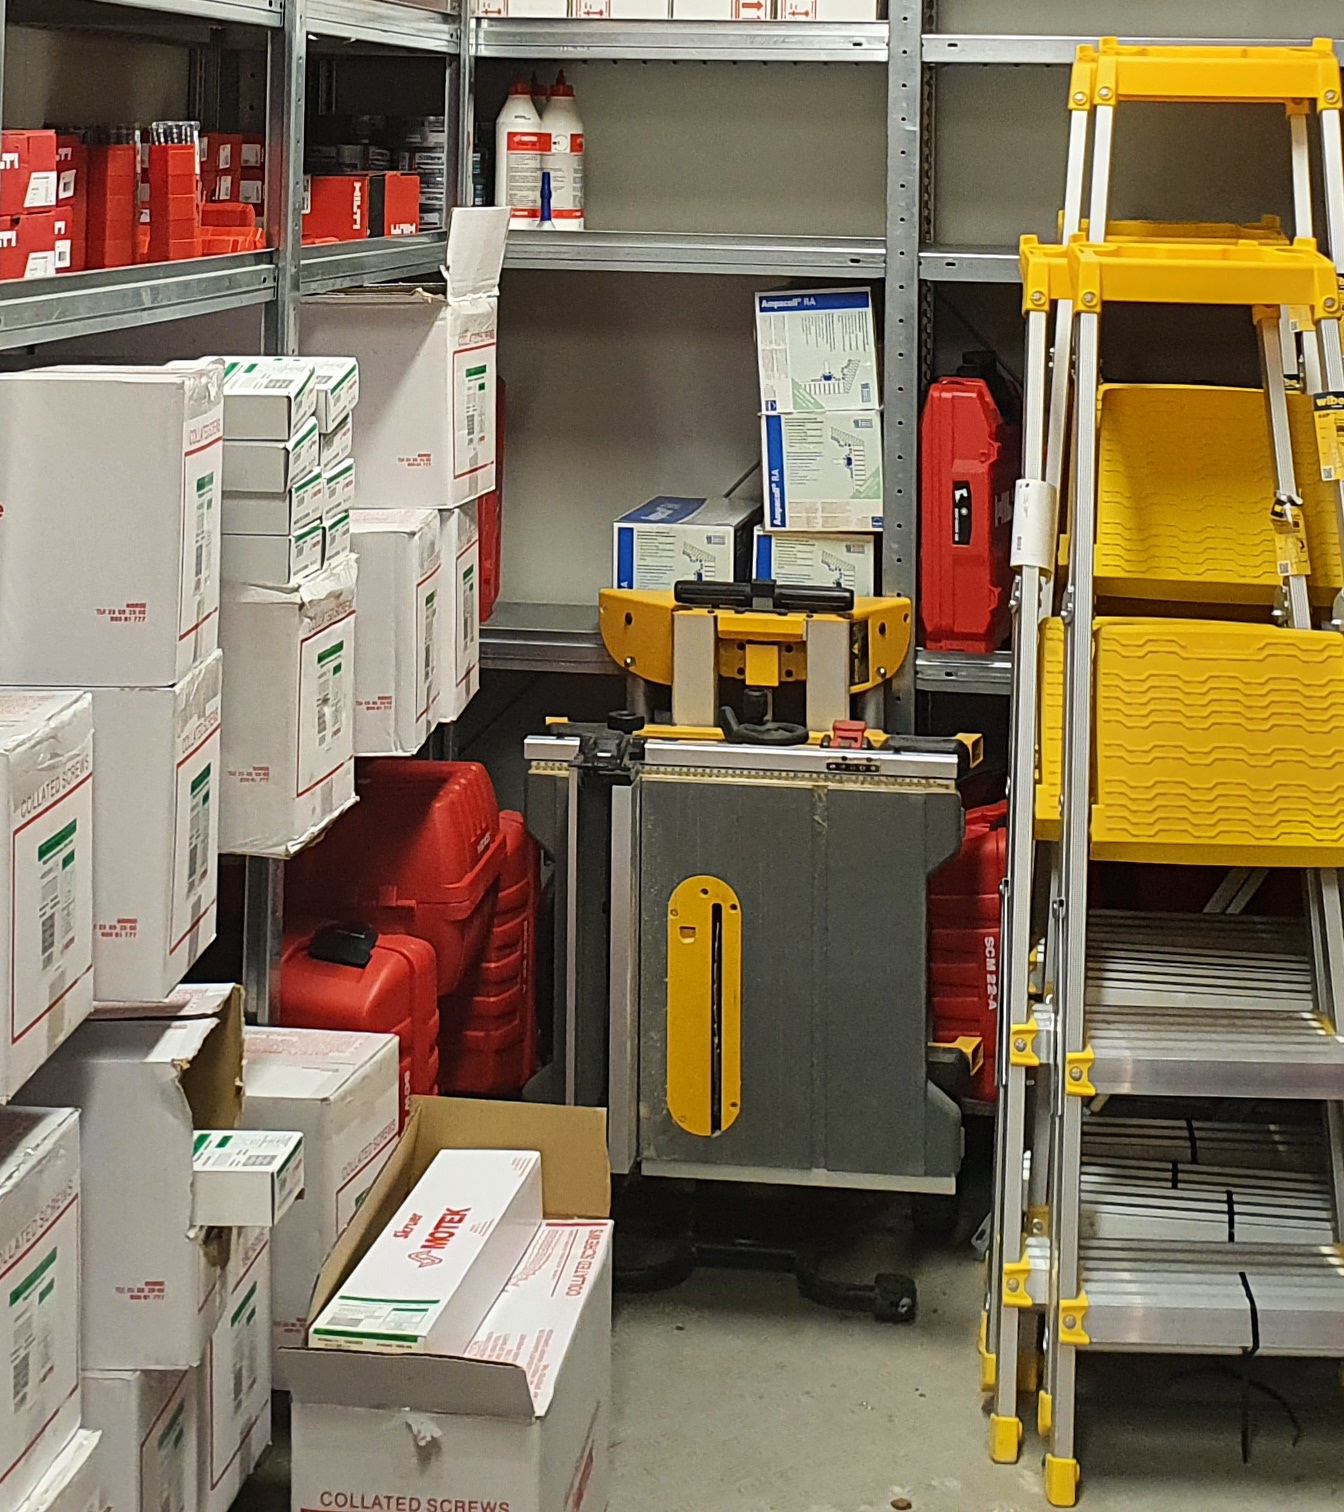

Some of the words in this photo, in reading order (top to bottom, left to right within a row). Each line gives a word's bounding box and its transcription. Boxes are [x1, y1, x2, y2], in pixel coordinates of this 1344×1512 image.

[353, 181, 361, 230] HILTI
[20, 775, 61, 819] COLLATED
[983, 935, 995, 972] SCM
[986, 974, 998, 1011] 22-A
[420, 1207, 472, 1250] MOTEK
[565, 1258, 592, 1297] COLLATED
[583, 1229, 604, 1259] SCREWS
[319, 1491, 422, 1512] COLLATED
